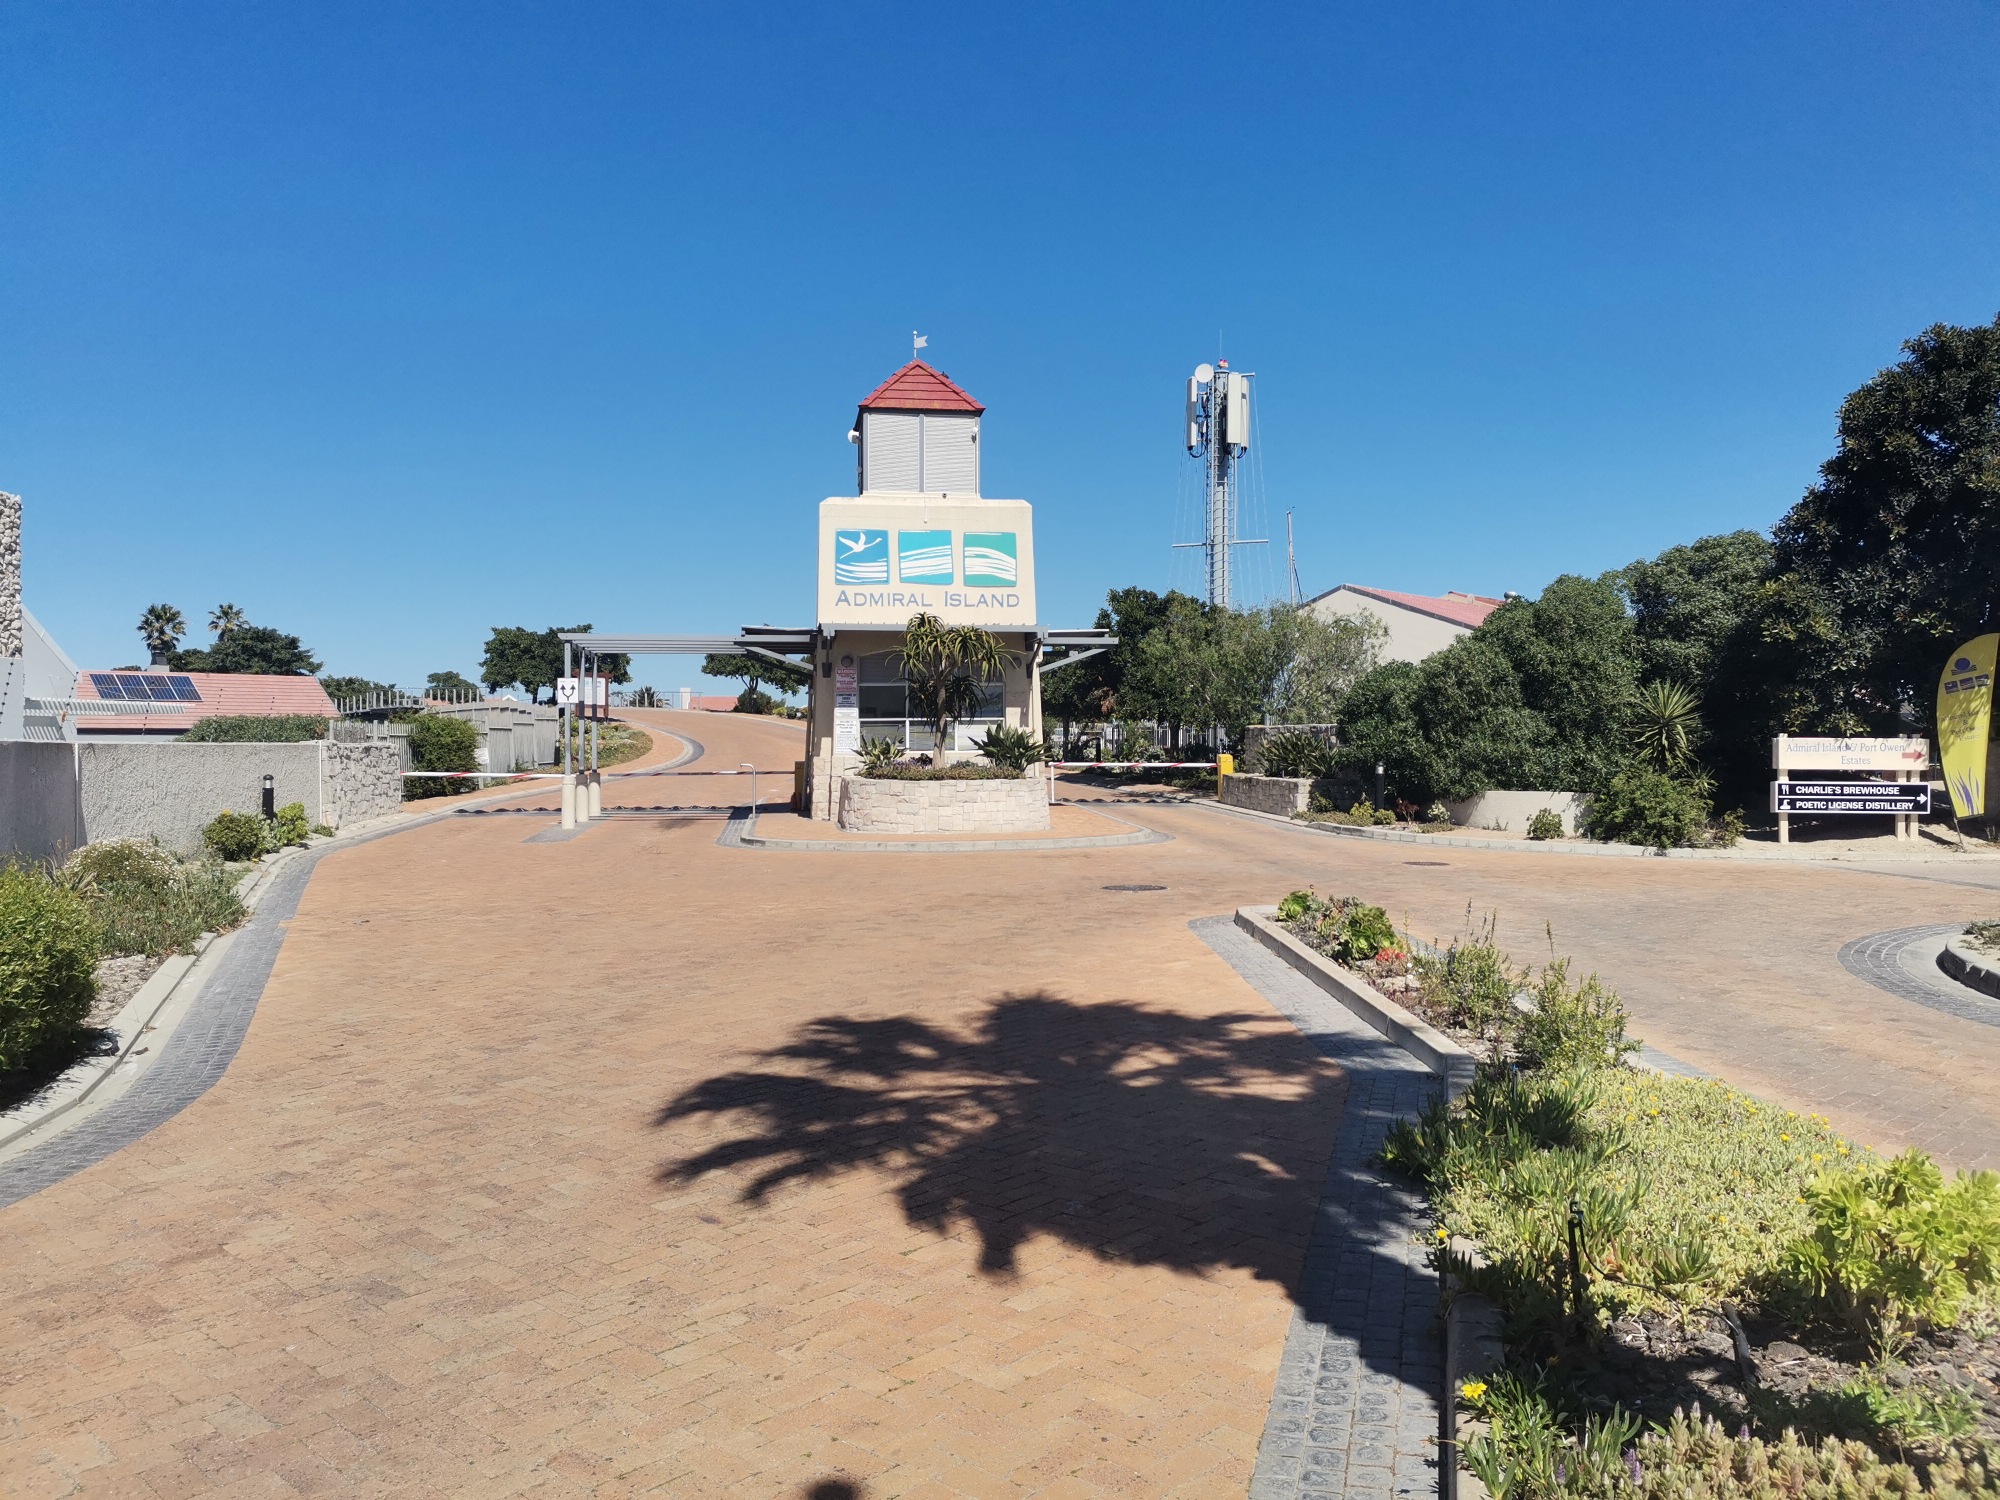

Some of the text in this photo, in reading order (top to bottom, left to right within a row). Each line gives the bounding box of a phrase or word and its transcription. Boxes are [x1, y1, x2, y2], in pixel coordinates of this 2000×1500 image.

[834, 589, 1020, 608] ADMIRAL ISLAND
[1786, 743, 1820, 752] Admiral
[1822, 743, 1847, 752] Island
[1860, 743, 1877, 752] Port
[1880, 743, 1905, 752] Owen
[1841, 756, 1871, 765] Estates
[1795, 786, 1900, 795] CHARLIE'S BREWHOUSE
[1796, 801, 1914, 810] POETIC LICENSE DISTILLERY
